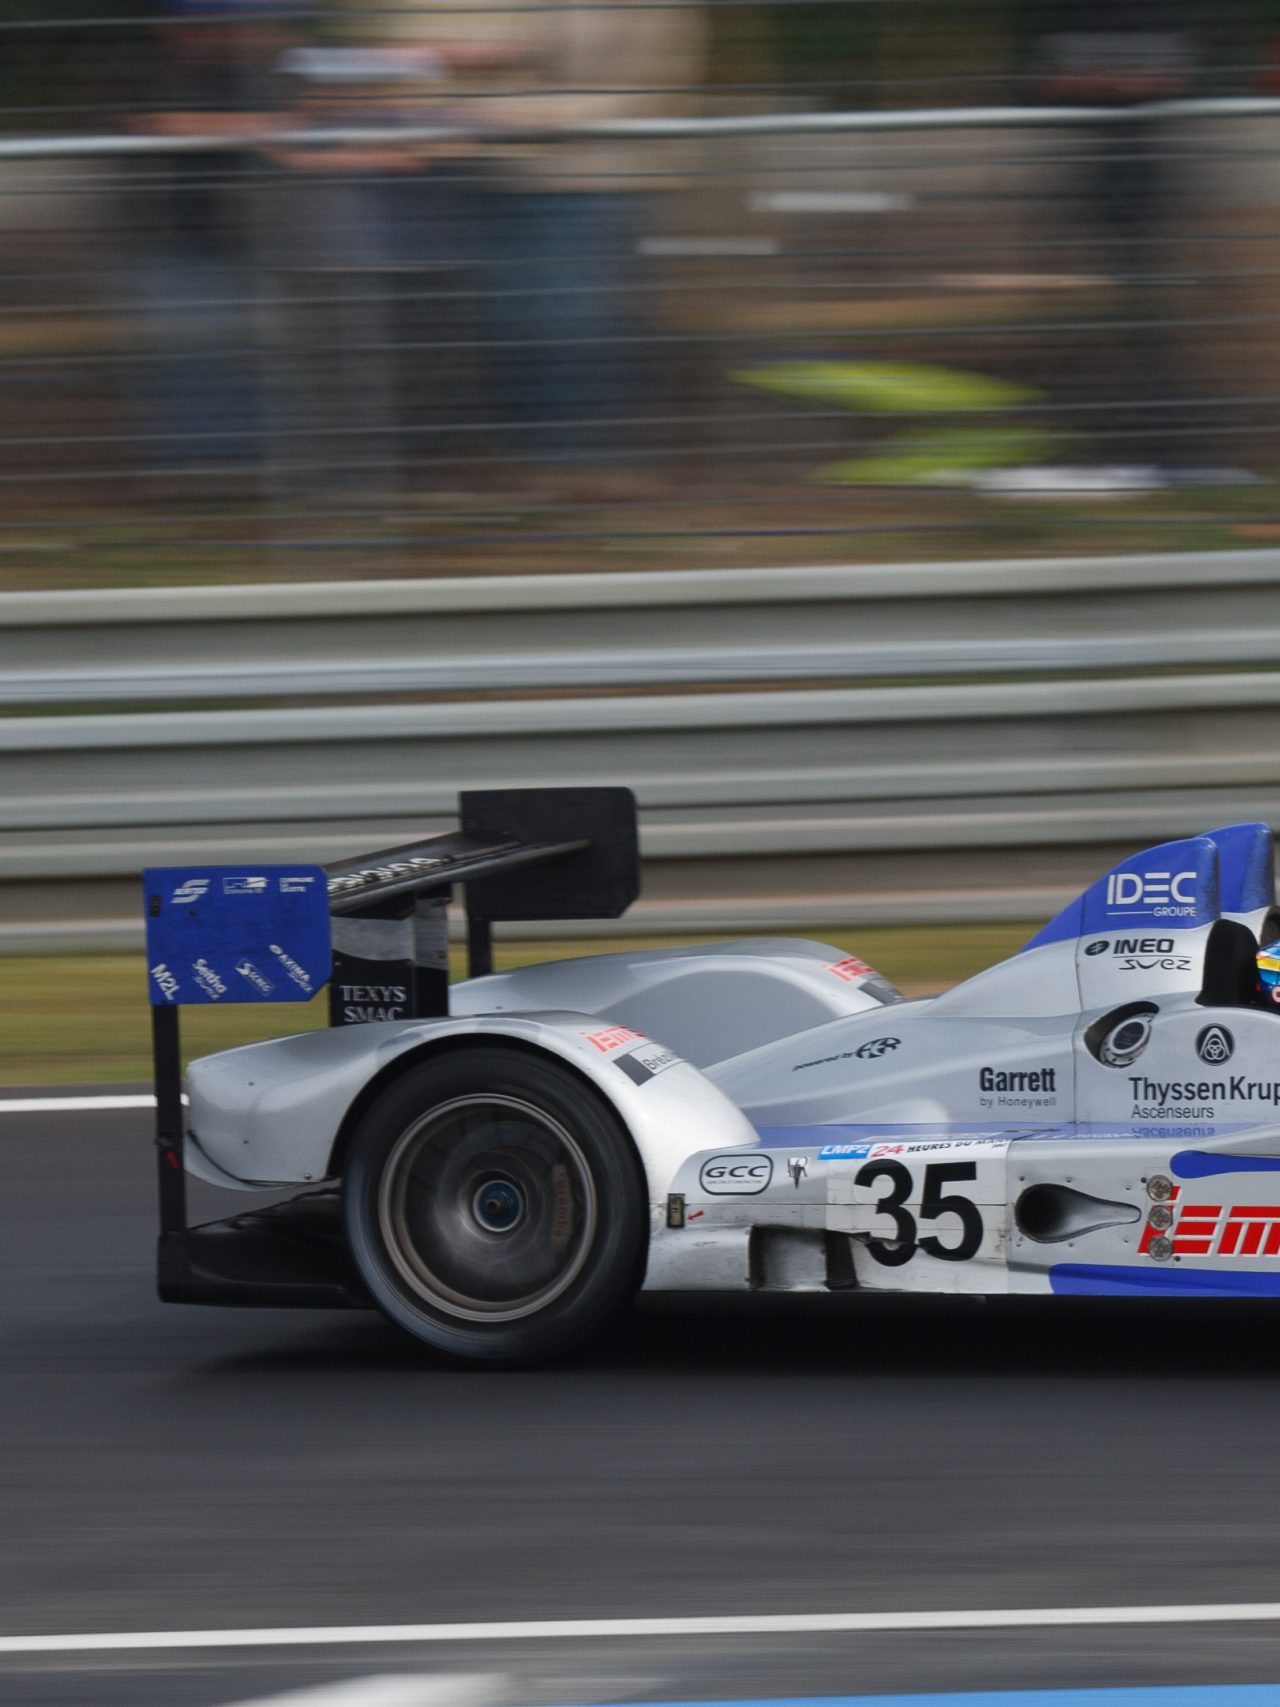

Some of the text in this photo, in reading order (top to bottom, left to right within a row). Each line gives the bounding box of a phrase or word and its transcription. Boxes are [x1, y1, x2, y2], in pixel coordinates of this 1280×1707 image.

[1106, 872, 1197, 905] IDEC
[1152, 906, 1197, 917] GROUPE
[1113, 939, 1175, 955] INEO
[151, 963, 180, 1001] M2L
[339, 985, 407, 1002] TEXYS
[344, 1006, 404, 1024] SMAC
[980, 1066, 1056, 1093] Garrett
[979, 1096, 1057, 1109] by Honeywell
[1131, 1104, 1215, 1119] Ascenseurs
[820, 1144, 871, 1155] LMP2
[870, 1145, 904, 1158] 24
[906, 1142, 952, 1153] HEURES
[705, 1165, 769, 1178] GCC
[854, 1159, 984, 1267] 35
